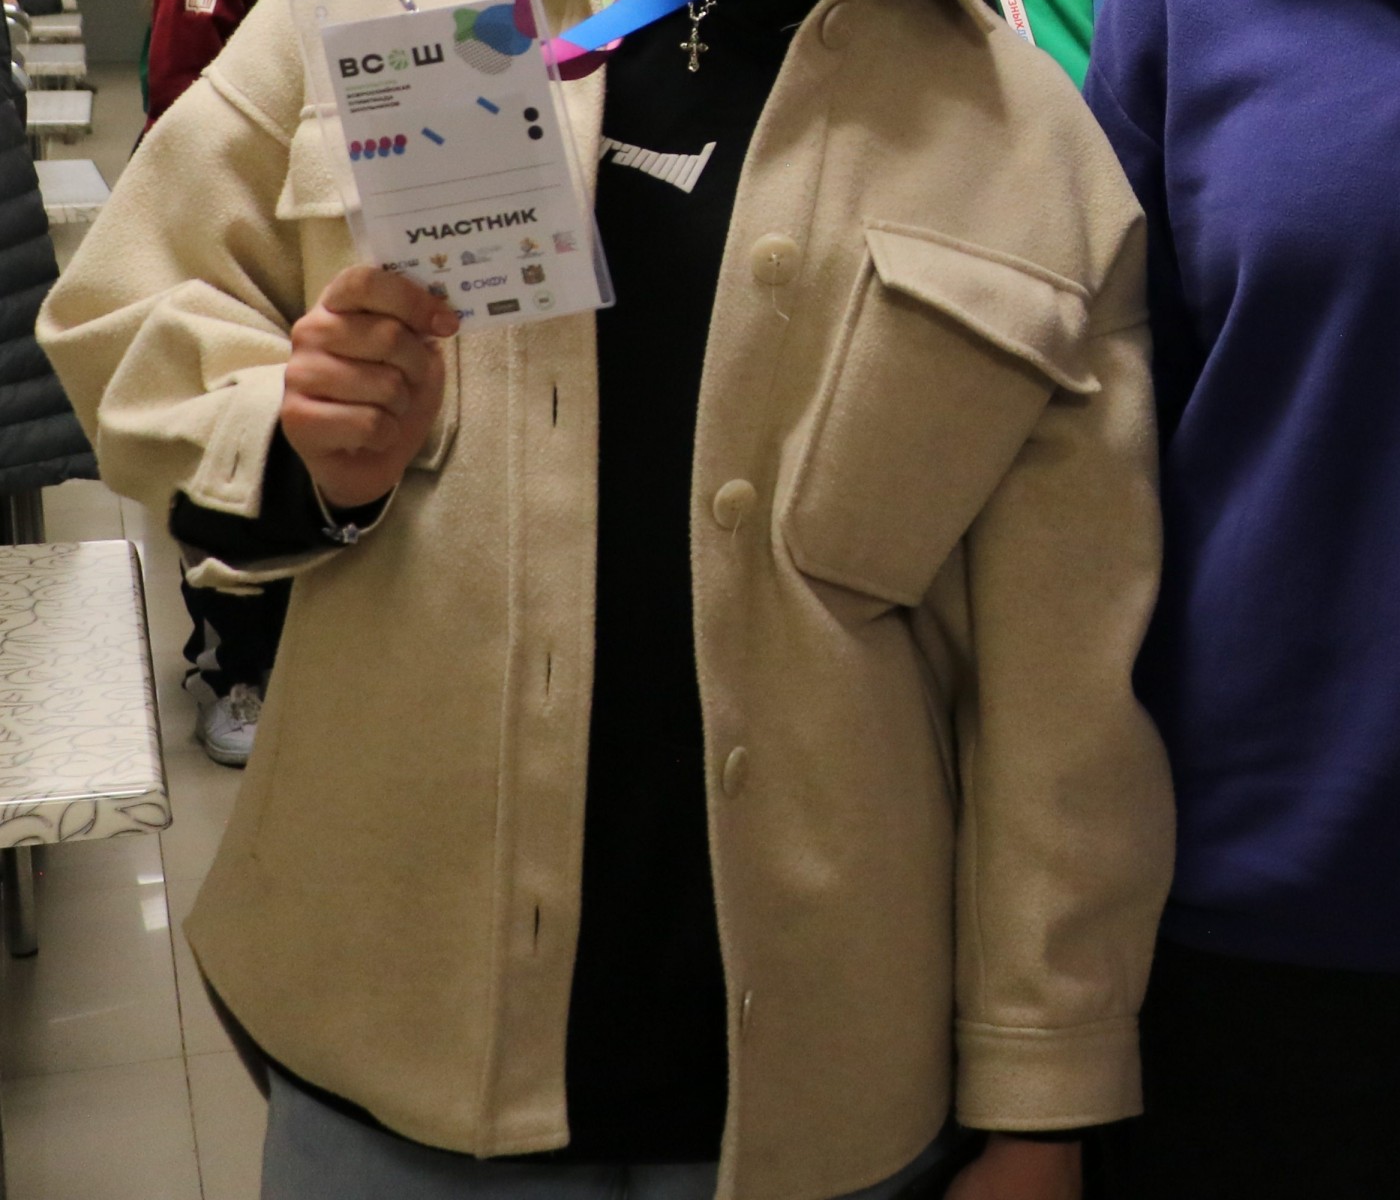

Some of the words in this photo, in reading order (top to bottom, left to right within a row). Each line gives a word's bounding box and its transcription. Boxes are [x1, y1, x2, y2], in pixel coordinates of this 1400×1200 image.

[600, 135, 717, 194] ranoid
[405, 207, 538, 244] УЧАСТНИК
[455, 308, 475, 320] ON
